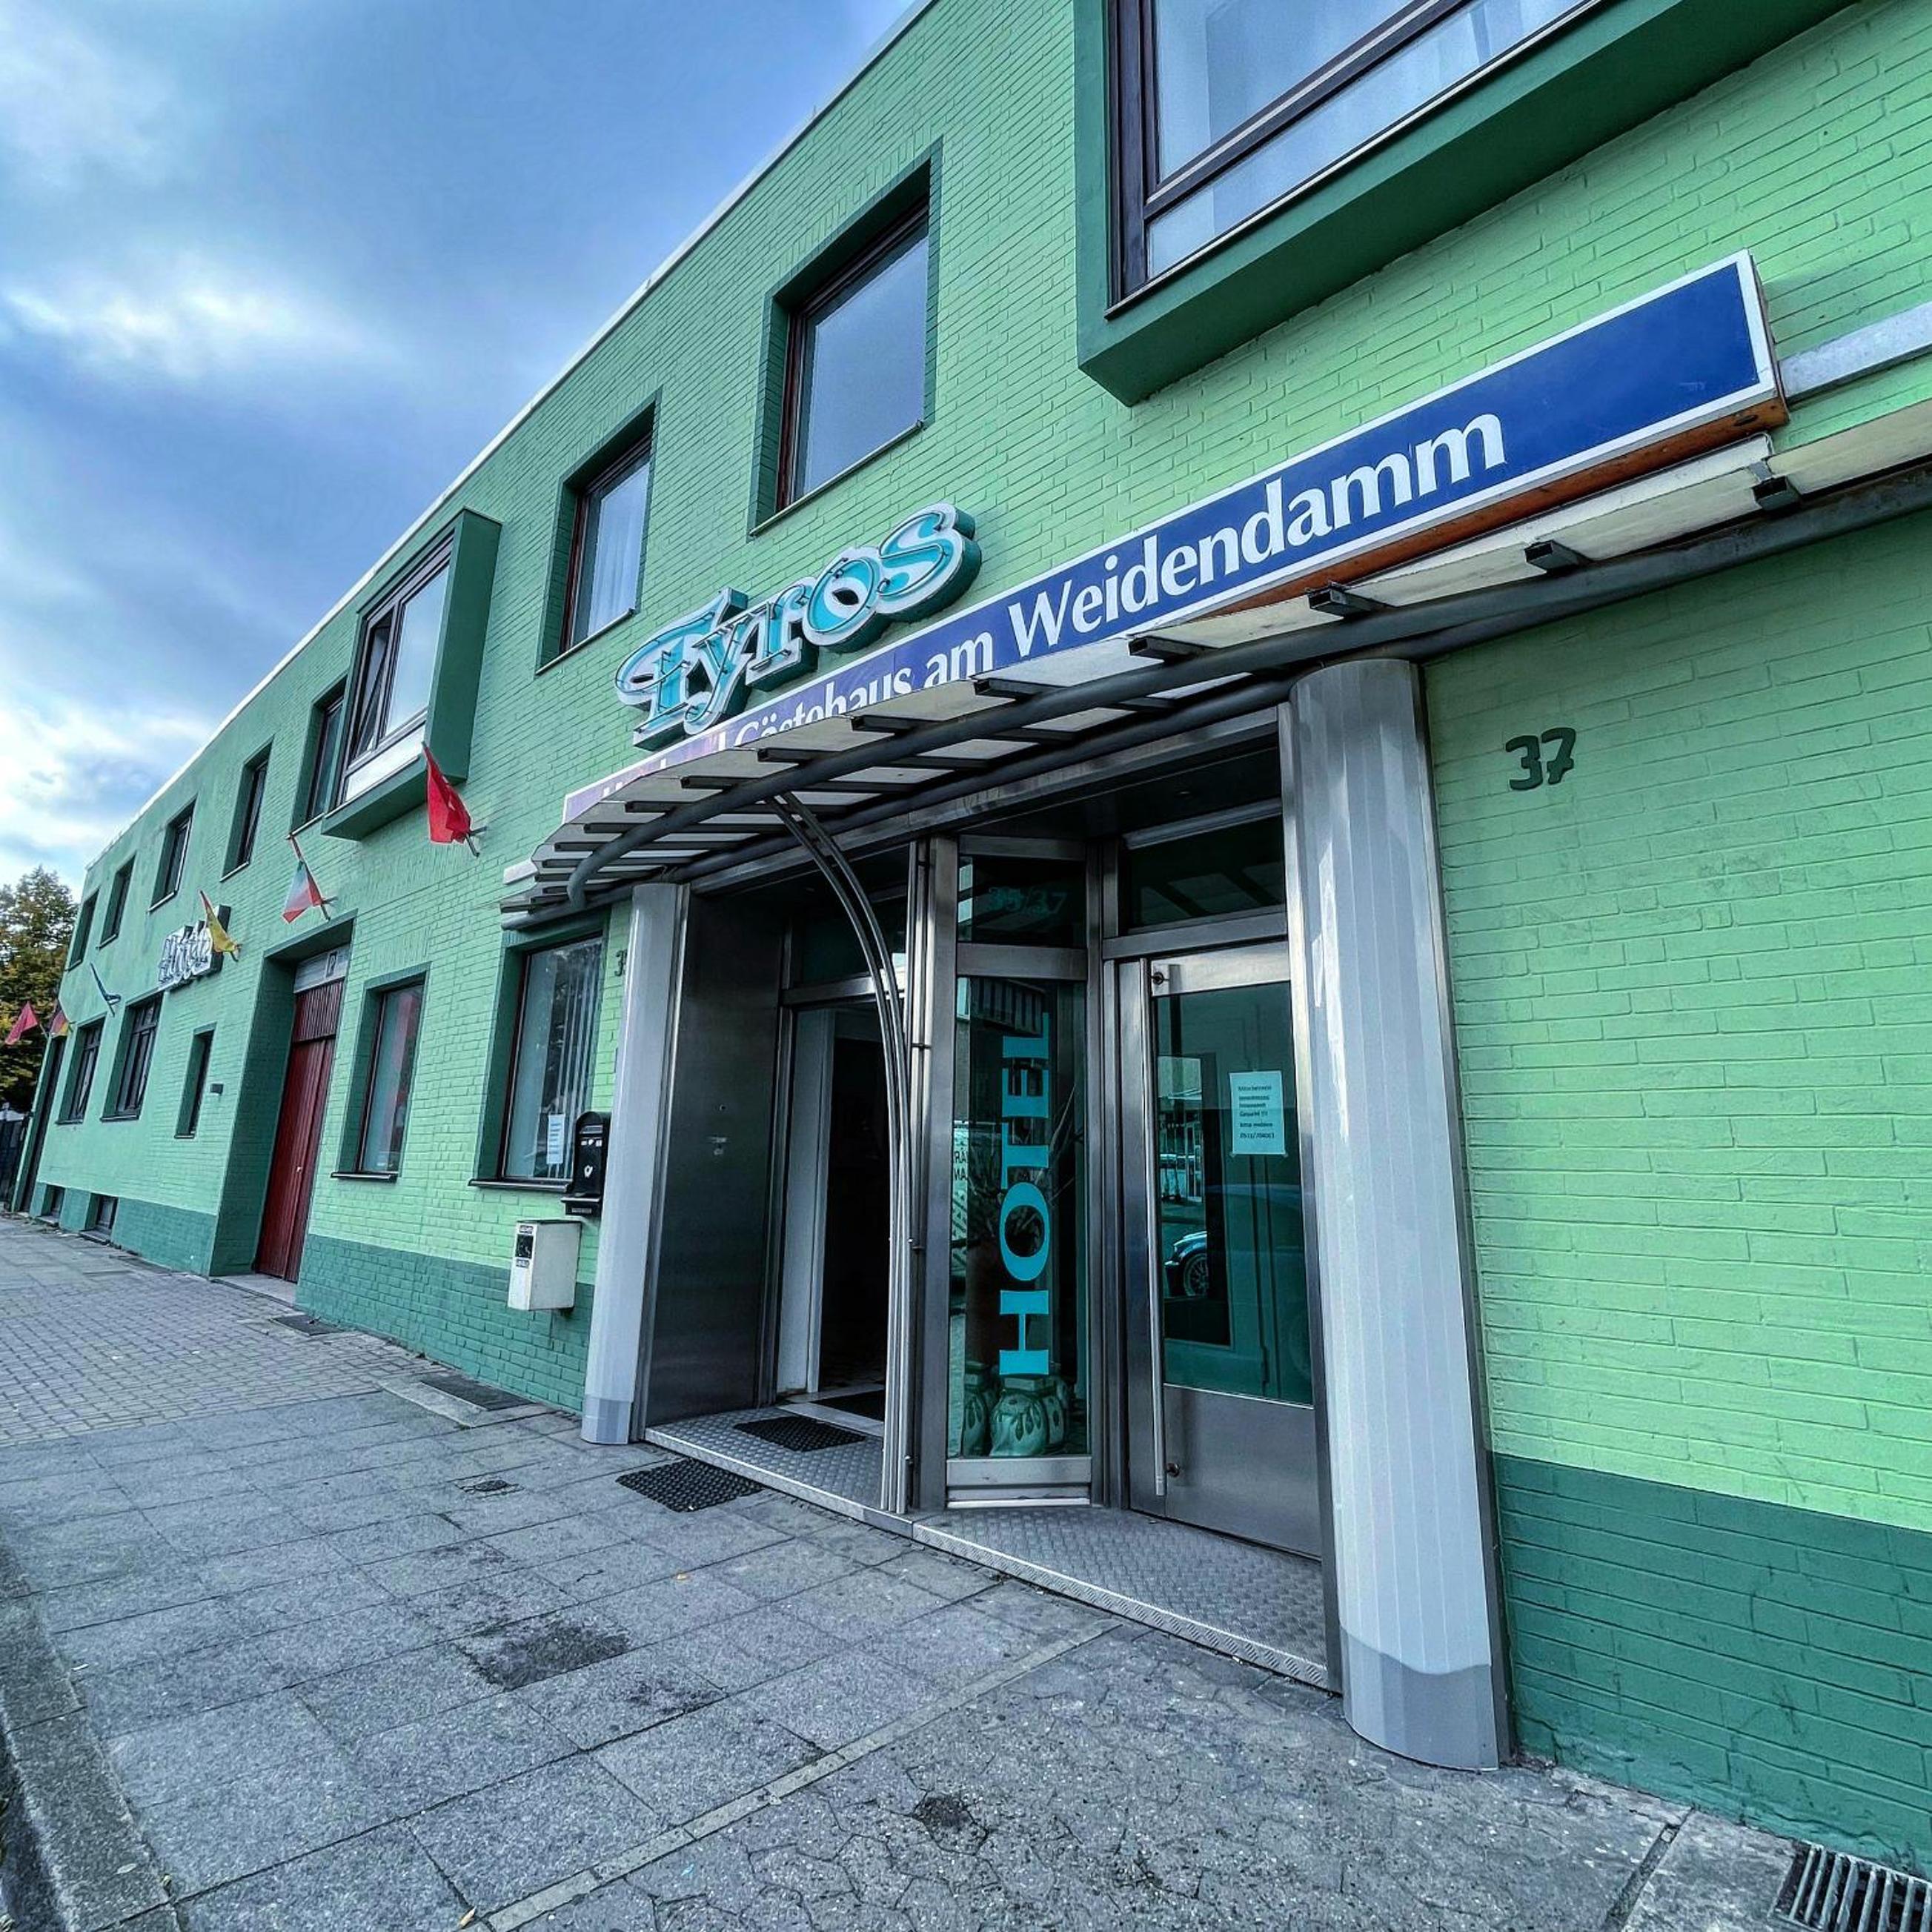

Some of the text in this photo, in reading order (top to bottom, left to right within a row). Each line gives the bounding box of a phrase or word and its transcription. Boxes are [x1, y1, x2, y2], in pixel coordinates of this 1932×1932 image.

[923, 632, 994, 689] am
[1008, 413, 1506, 657] Weidendamm
[1505, 727, 1576, 791] 37
[999, 1012, 1051, 1375] HOTEL
